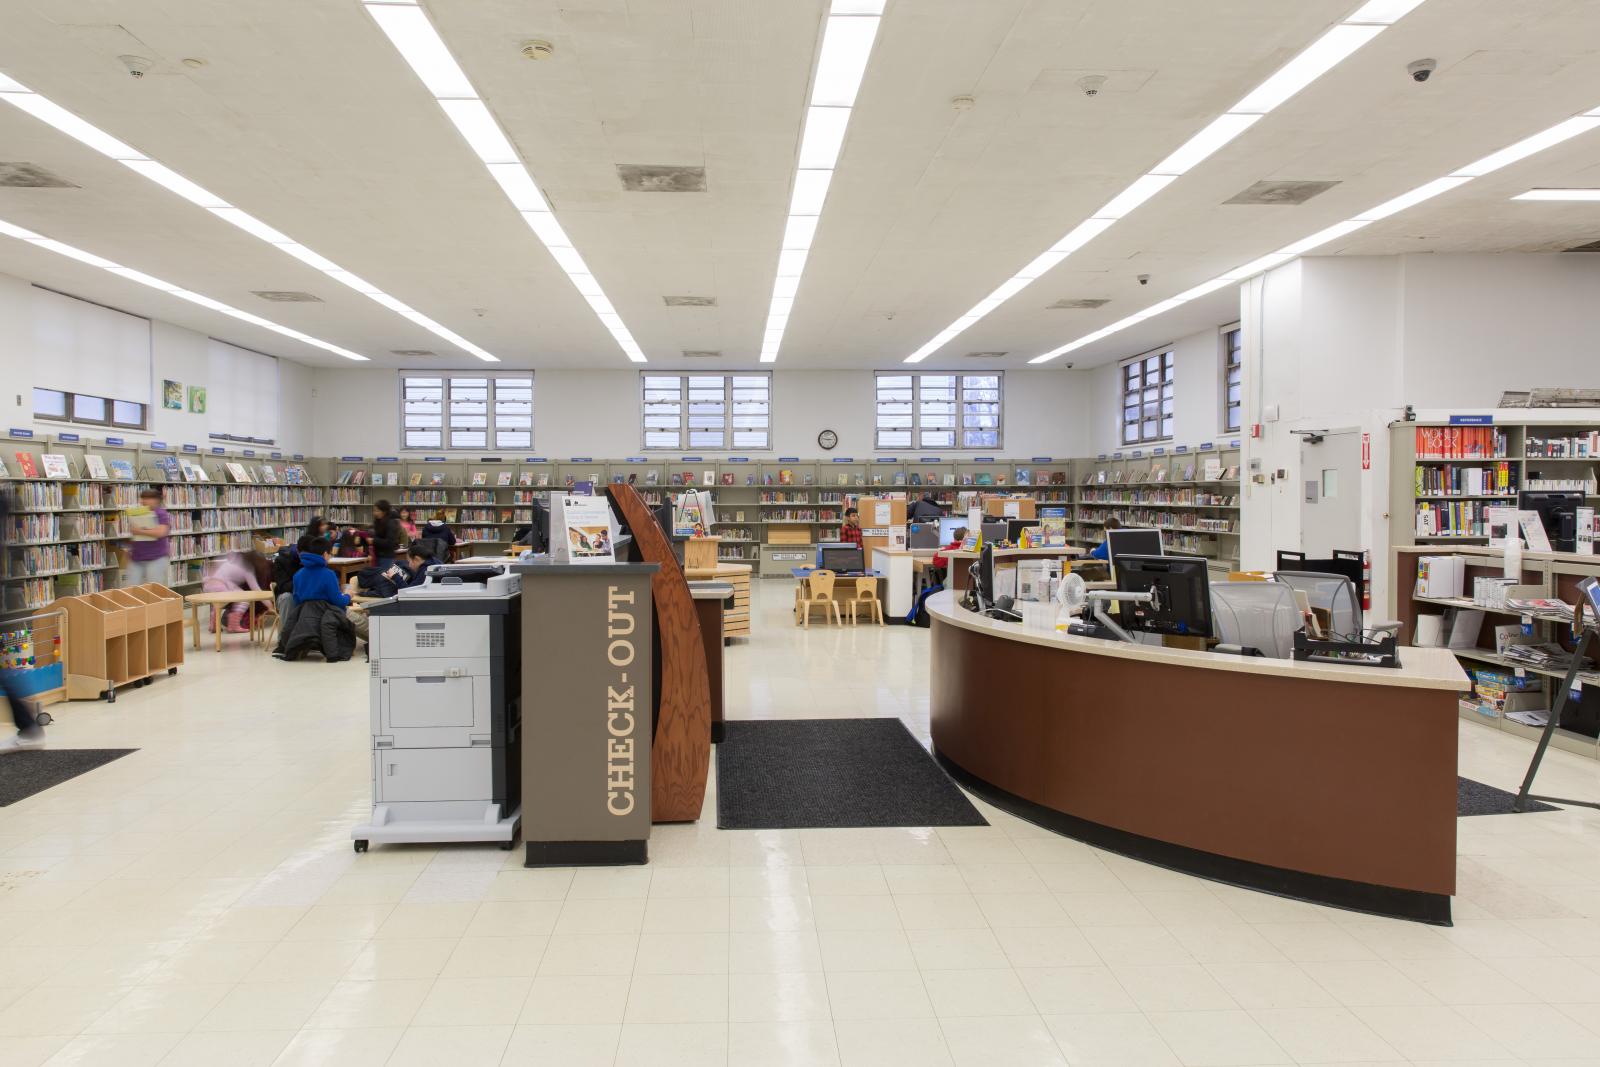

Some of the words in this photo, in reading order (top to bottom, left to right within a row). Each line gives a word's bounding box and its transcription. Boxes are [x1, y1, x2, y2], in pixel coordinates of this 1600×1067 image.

[1422, 428, 1459, 438] WORLD
[1428, 437, 1457, 448] BOOK
[608, 586, 634, 815] CHECK-OUT
